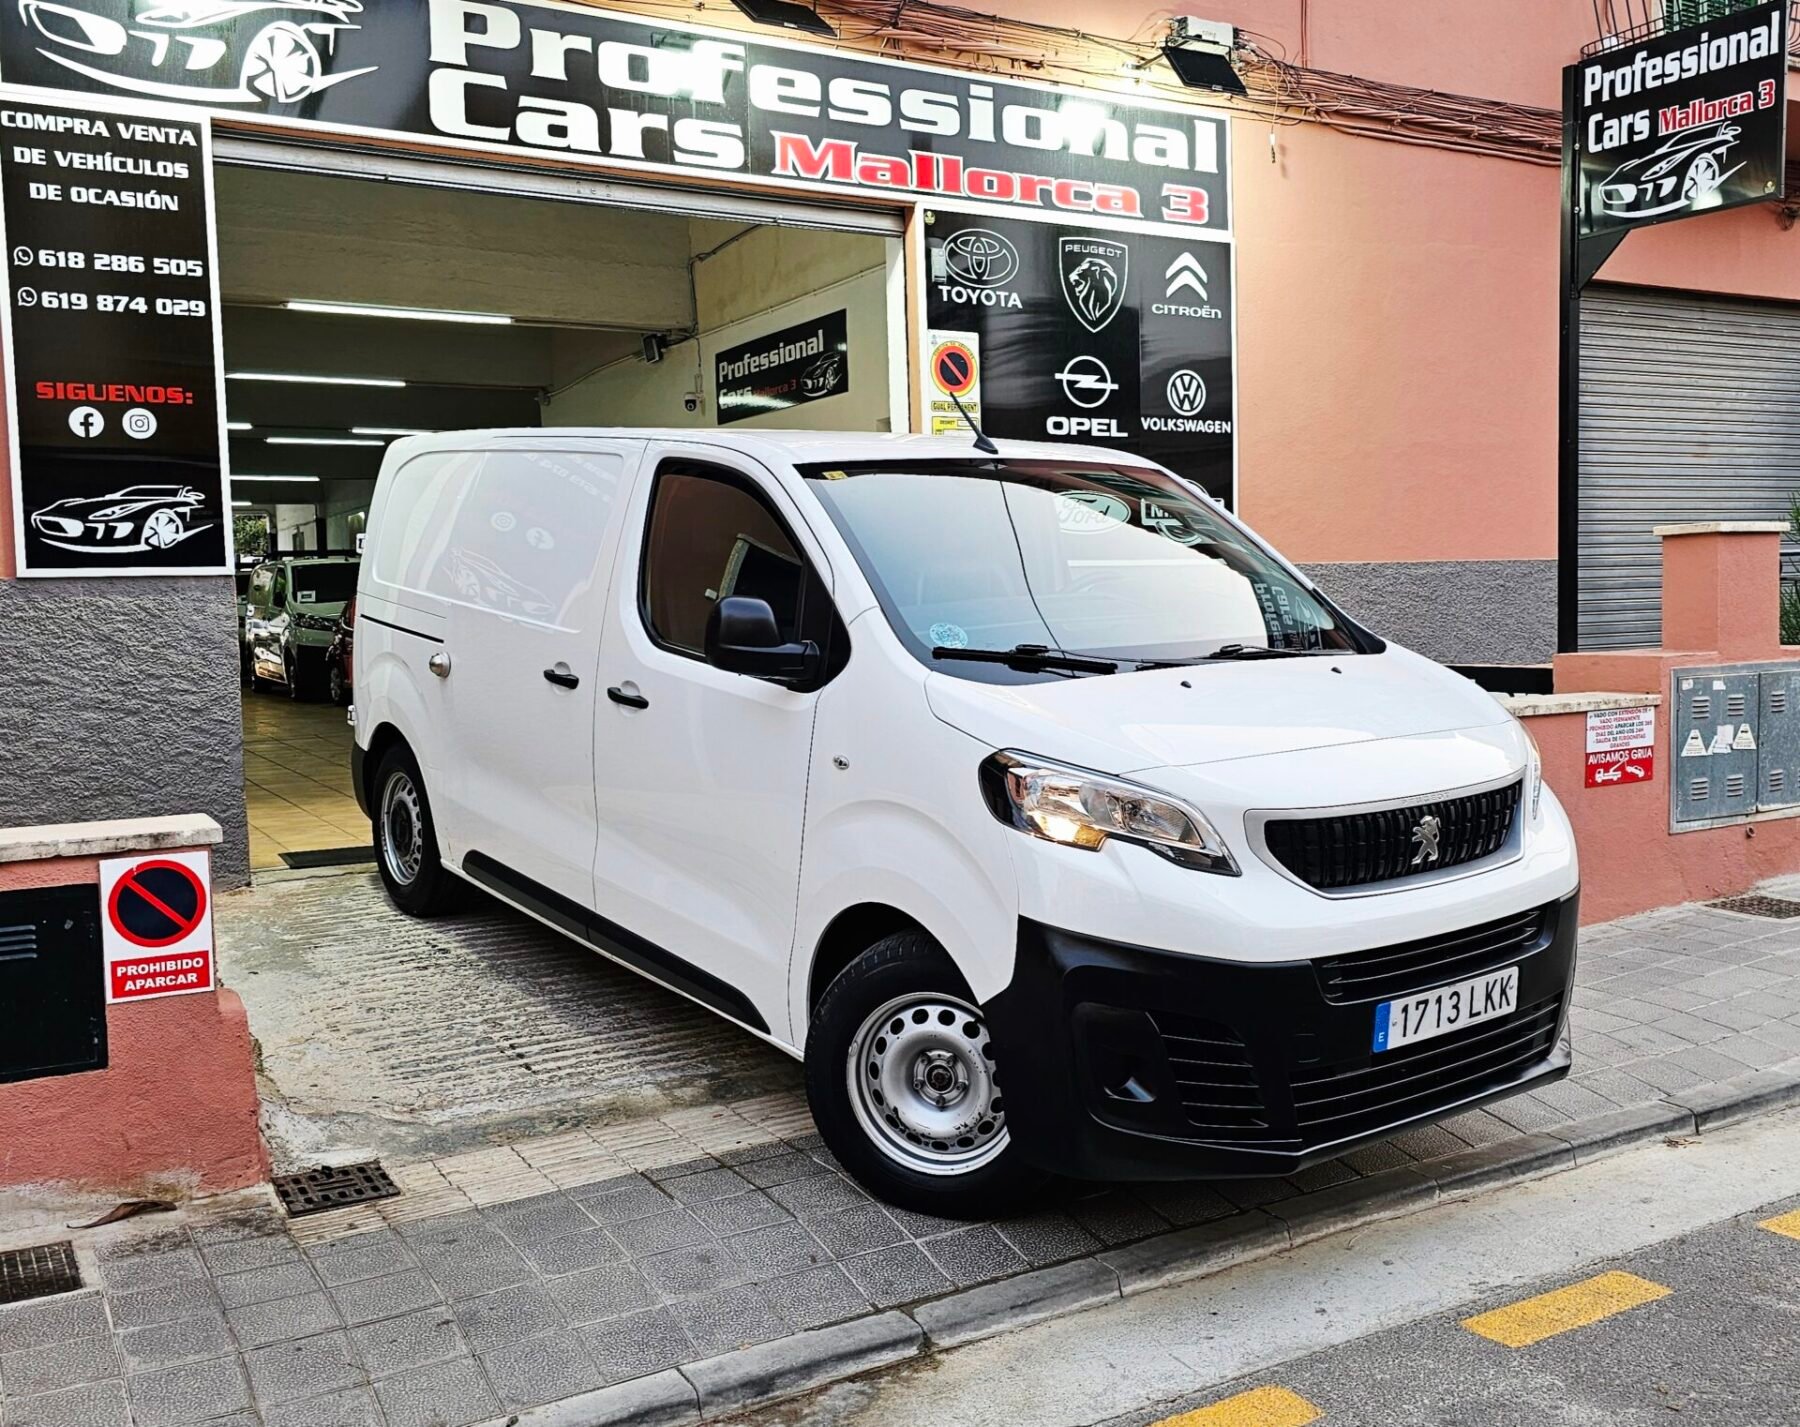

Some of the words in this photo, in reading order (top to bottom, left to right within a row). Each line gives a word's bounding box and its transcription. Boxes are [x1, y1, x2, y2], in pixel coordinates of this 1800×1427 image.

[1584, 11, 1780, 107] Professional
[429, 0, 1219, 173] Professional
[0, 110, 111, 137] COMPRA
[117, 122, 198, 146] VENTA
[1588, 109, 1650, 154] Cars
[1658, 91, 1754, 136] Mallorca
[1758, 78, 1776, 109] 3
[428, 68, 746, 170] Cars
[770, 130, 1144, 219] Mallorca
[1161, 182, 1209, 226] 3
[13, 146, 47, 165] DE
[54, 149, 190, 179] VEHÍCULOS
[29, 182, 62, 201] DE
[70, 186, 179, 211] OCASIÓN
[38, 249, 85, 269] 618
[94, 253, 146, 273] 286
[153, 257, 204, 277] 505
[1065, 244, 1123, 259] PEUGEOT
[41, 291, 88, 310] 619
[97, 294, 148, 314] 874
[155, 298, 206, 317] 029
[937, 285, 1023, 309] TOYOTA
[1151, 303, 1222, 319] CITROËN
[719, 329, 824, 383] Professional
[35, 381, 194, 405] SIGUENOS:
[1046, 416, 1129, 437] OPEL
[1140, 416, 1232, 434] VOLKSWAGEN
[1588, 750, 1630, 765] AVISAMOS
[1631, 748, 1653, 760] GRUA
[116, 957, 204, 977] PROHIBIDO
[124, 973, 198, 991] APARCAR
[1401, 990, 1461, 1038] 1713
[1469, 974, 1513, 1019] LKK
[1378, 1031, 1385, 1042] E
